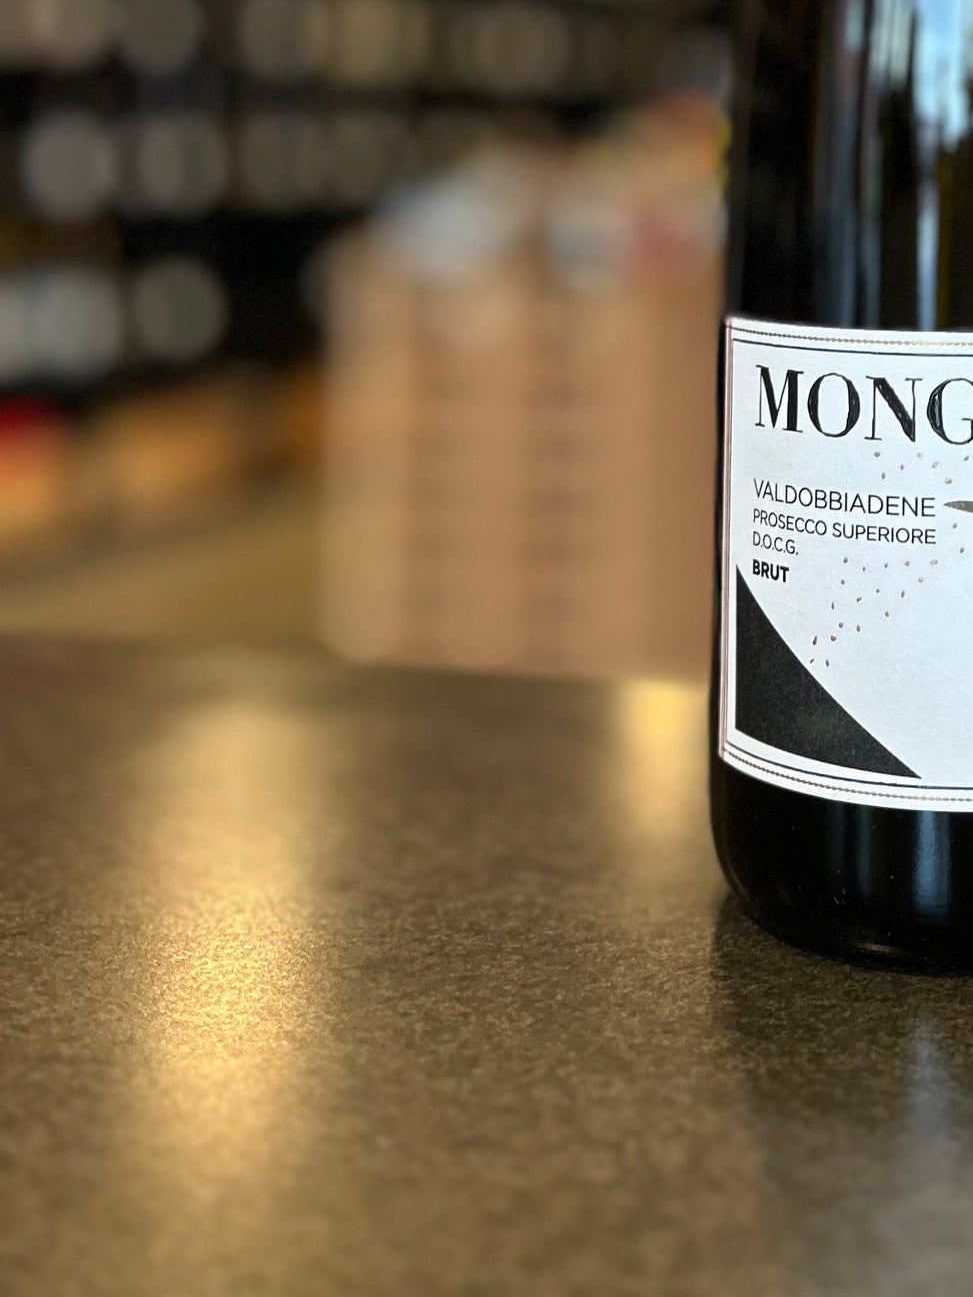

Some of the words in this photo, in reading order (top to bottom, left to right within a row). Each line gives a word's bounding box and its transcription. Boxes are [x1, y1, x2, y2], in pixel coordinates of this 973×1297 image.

[753, 477, 936, 517] VALDOBBIADENE
[752, 508, 828, 536] PROSECCO
[831, 522, 937, 545] SUPERIORE
[752, 530, 799, 555] D.O.C.G.
[752, 559, 790, 583] BRUT
